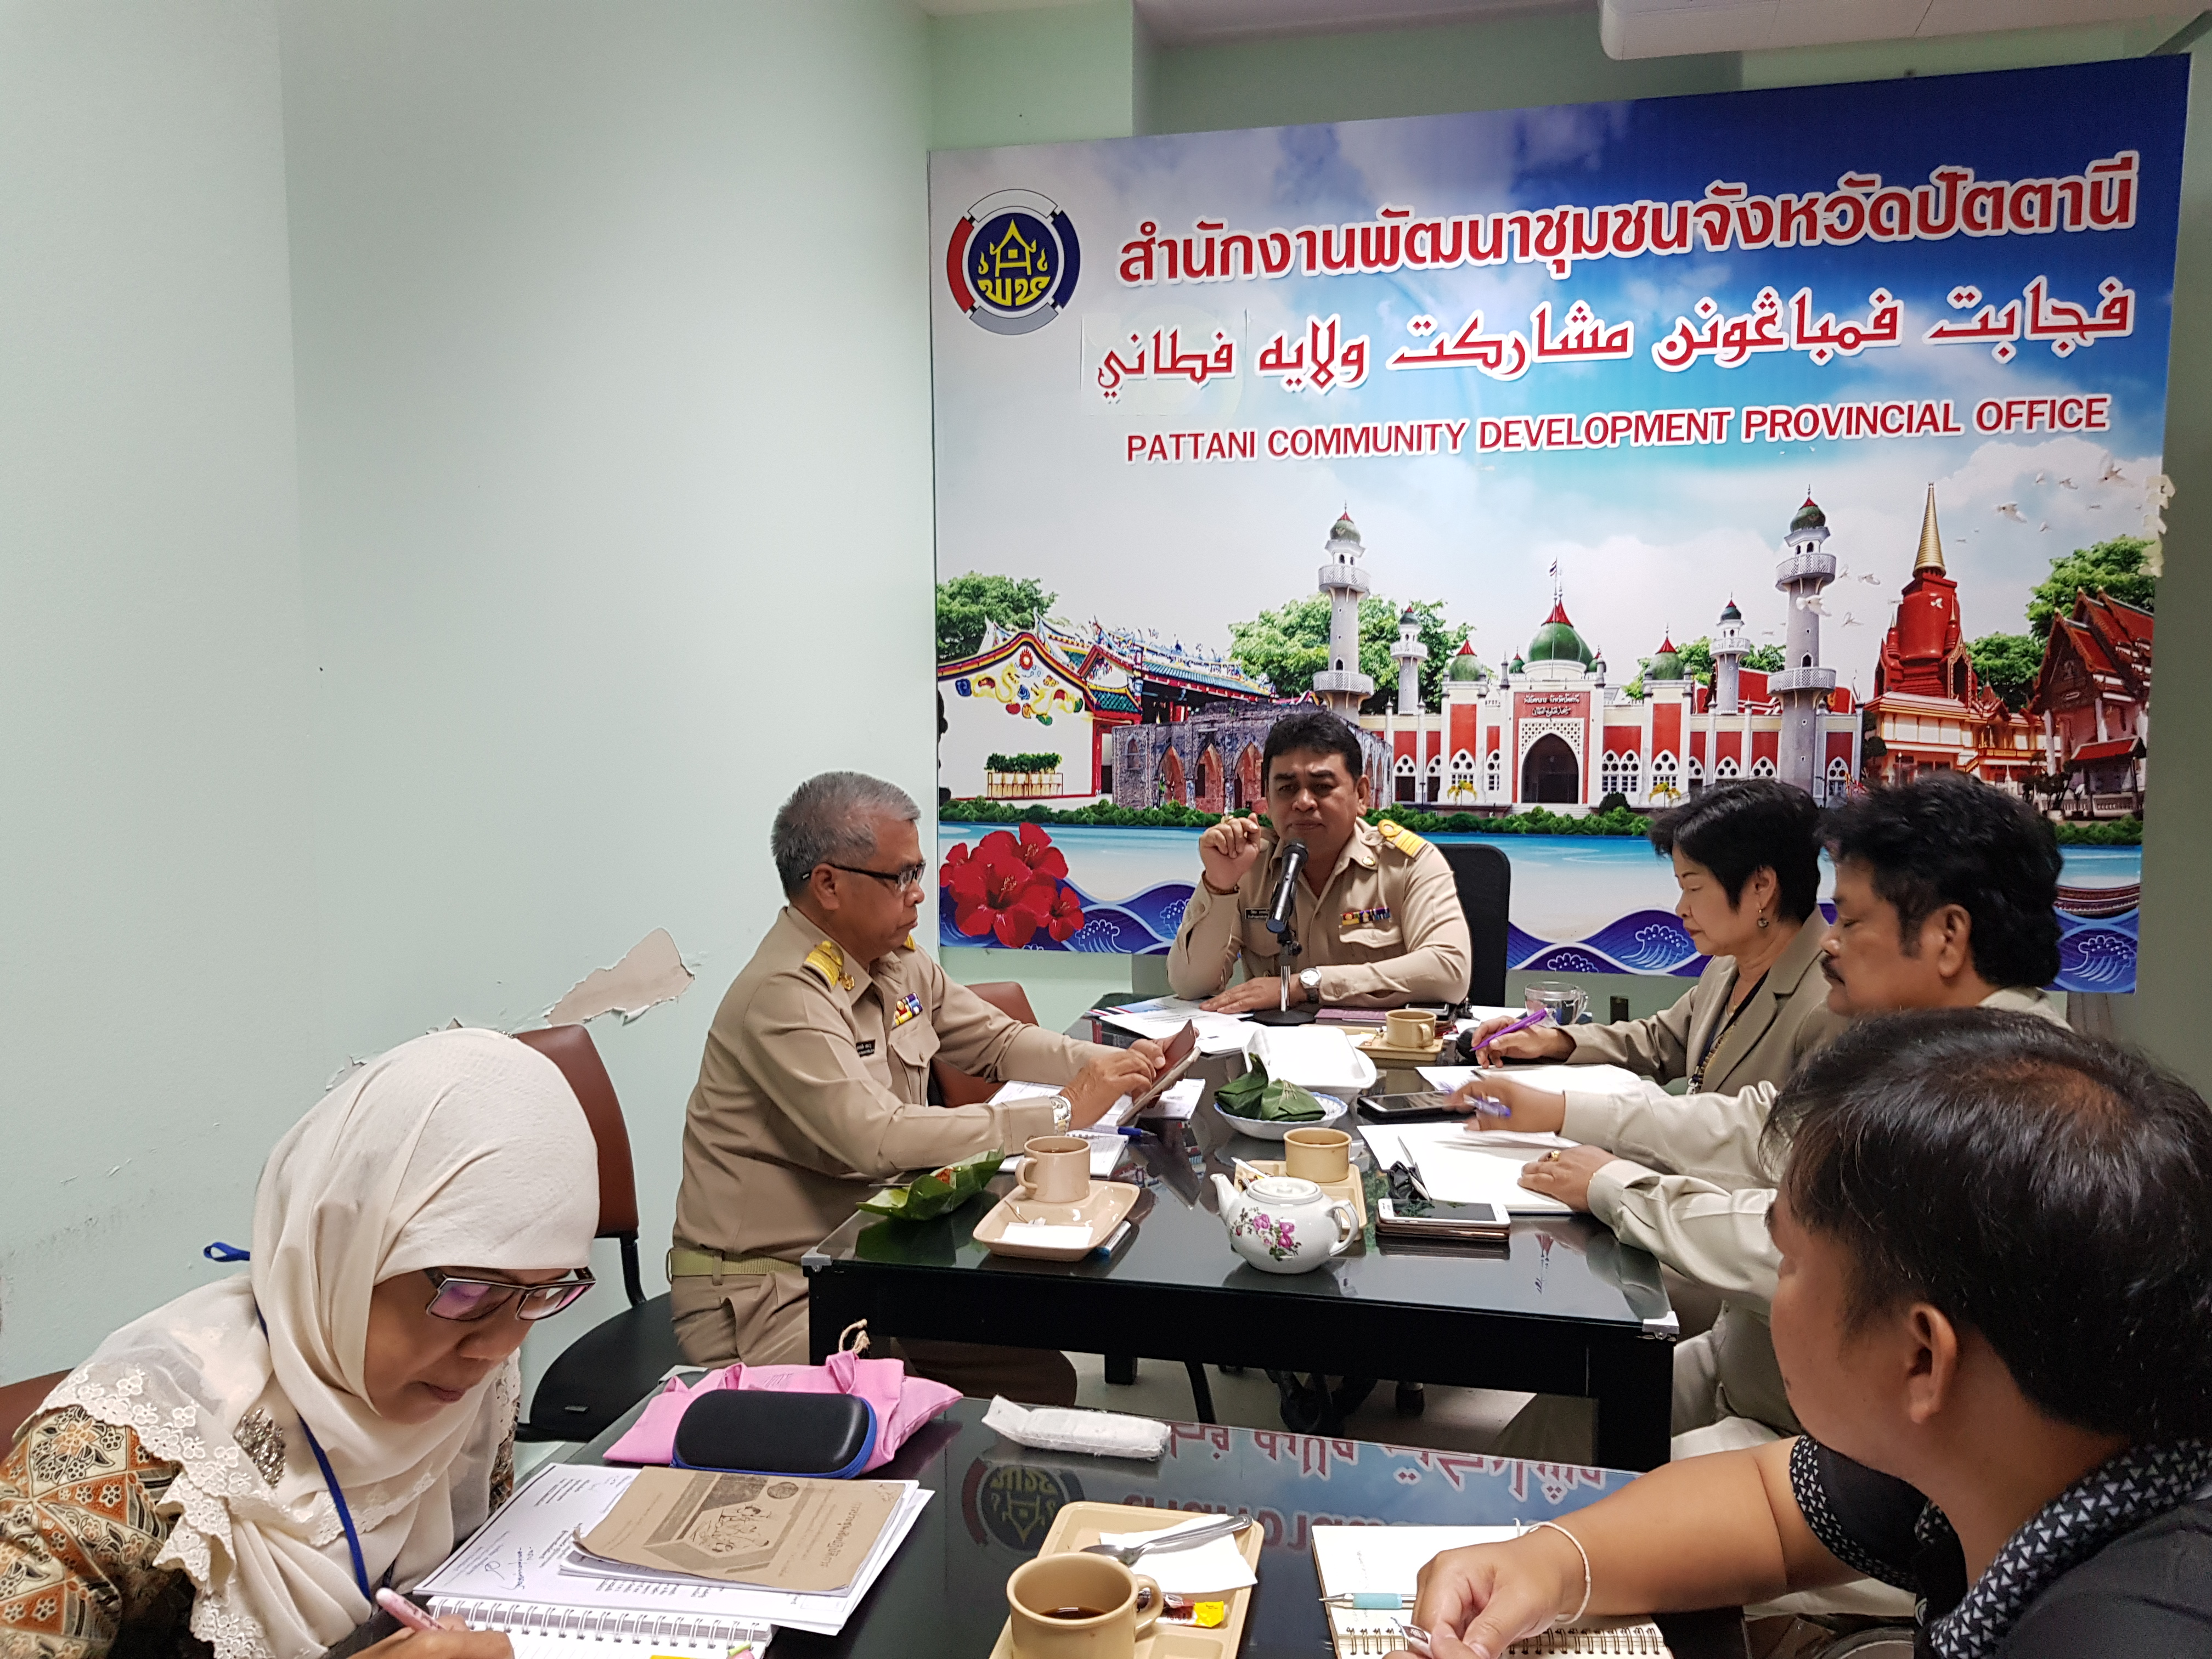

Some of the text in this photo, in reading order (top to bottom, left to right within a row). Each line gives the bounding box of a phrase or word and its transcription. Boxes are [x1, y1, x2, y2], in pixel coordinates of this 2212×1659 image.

[1119, 157, 2133, 282] สำนักงานพัฒนาชุมชนจังหวัดปัตตานี
[1393, 306, 1629, 375] مشاركت
[1127, 397, 2108, 461] PATTANI COMMUNITY DEVELOPMENT PROVINCIAL OFFICE
